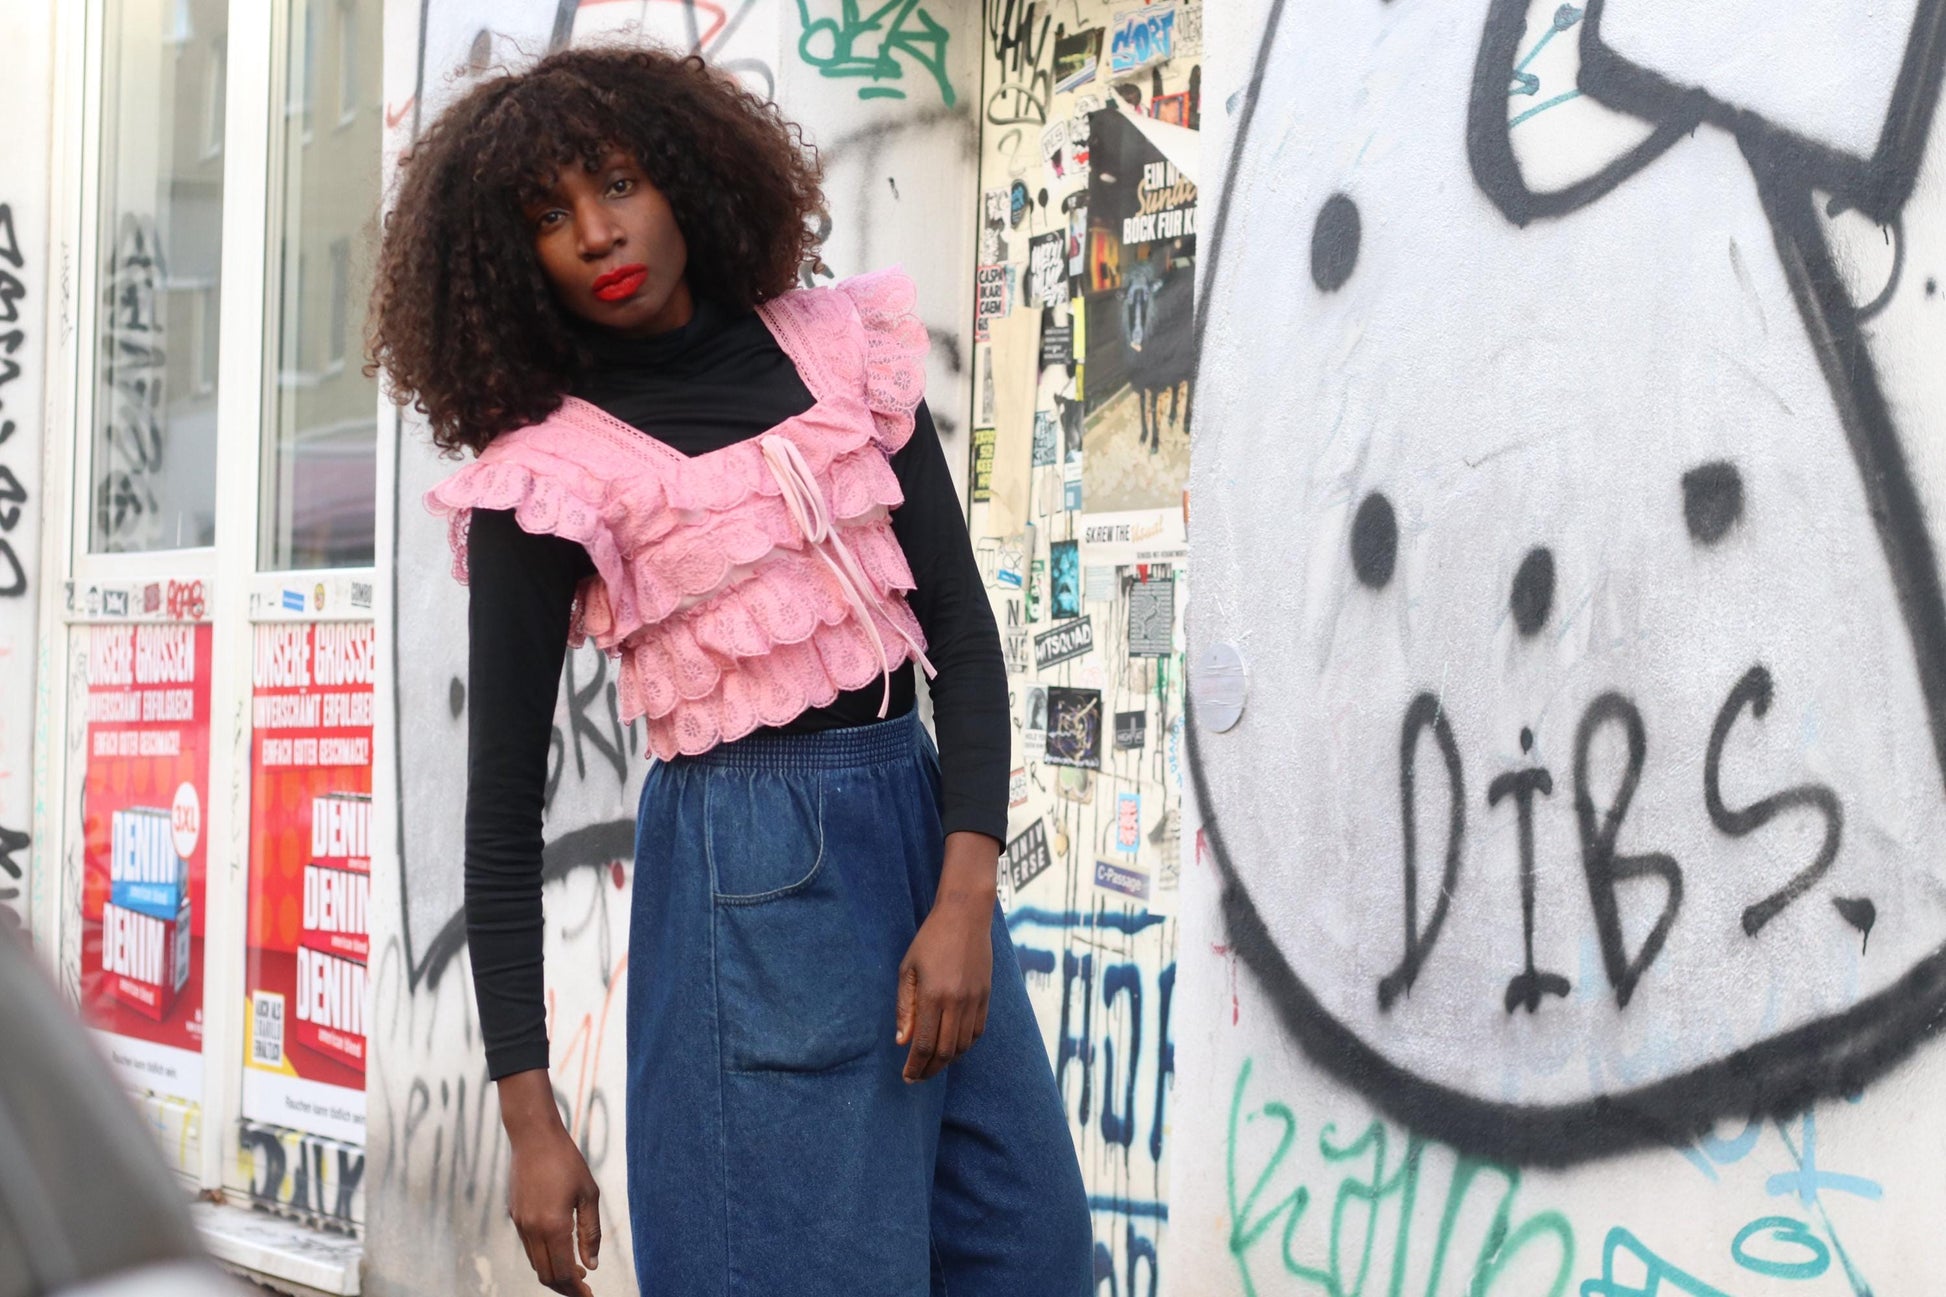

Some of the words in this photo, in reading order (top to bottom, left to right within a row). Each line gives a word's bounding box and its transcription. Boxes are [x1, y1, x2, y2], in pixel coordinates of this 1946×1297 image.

[1123, 214, 1157, 245] BOCK
[1116, 525, 1130, 542] THE
[135, 623, 195, 684] GROSSEN
[253, 622, 311, 687] UNSERE
[1011, 822, 1044, 864] UNIV
[1012, 845, 1046, 887] ERSE
